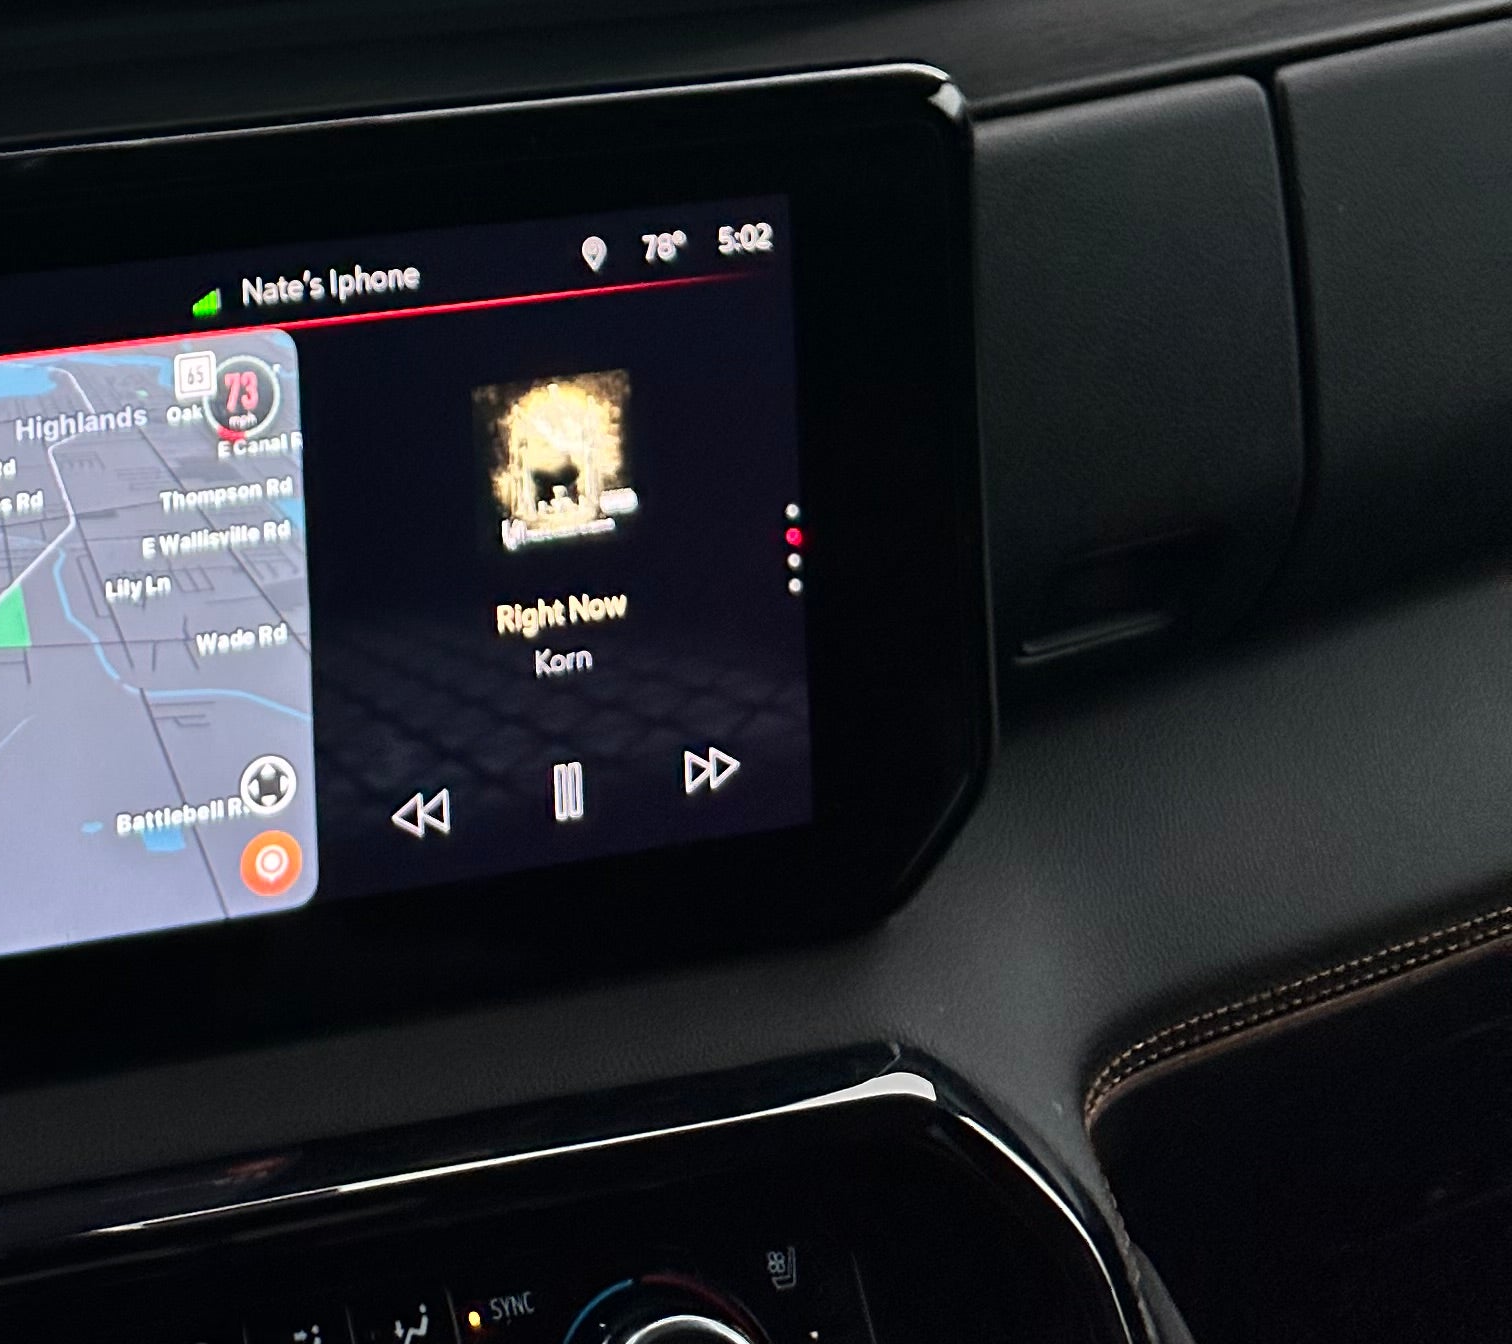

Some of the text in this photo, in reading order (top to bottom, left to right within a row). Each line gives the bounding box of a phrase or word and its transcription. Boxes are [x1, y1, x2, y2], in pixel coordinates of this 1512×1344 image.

[718, 222, 774, 254] 5:02
[242, 264, 421, 306] Nate's Iphone
[224, 371, 259, 412] 73
[15, 406, 148, 442] Highlands
[229, 412, 258, 429] mph
[218, 441, 231, 459] E
[233, 433, 288, 456] Canal
[16, 490, 44, 514] Rd
[160, 475, 293, 512] Thompson Rd
[142, 519, 292, 560] E Wallisville Rd
[105, 575, 171, 603] Lily Ln
[496, 593, 628, 638] Right Now
[196, 623, 288, 656] Wade Rd
[535, 648, 593, 679] Korn
[490, 1291, 536, 1320] SYNC
